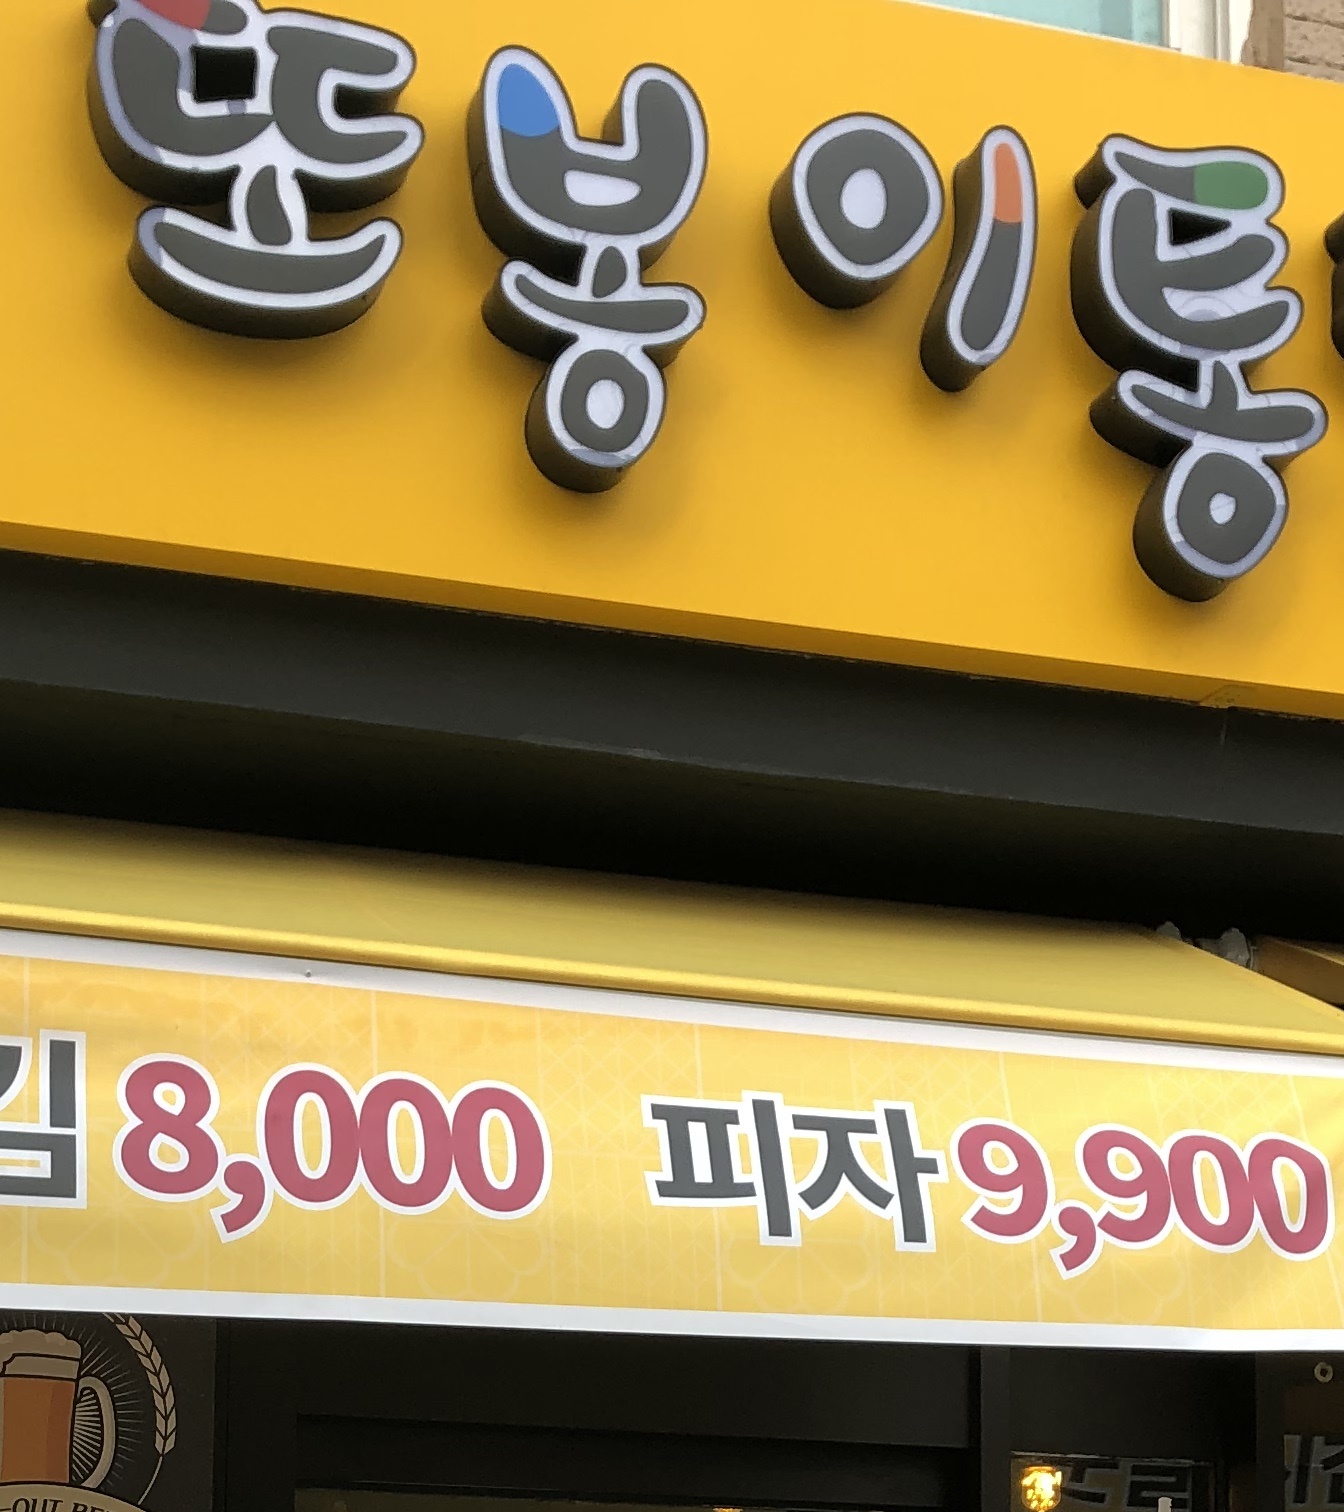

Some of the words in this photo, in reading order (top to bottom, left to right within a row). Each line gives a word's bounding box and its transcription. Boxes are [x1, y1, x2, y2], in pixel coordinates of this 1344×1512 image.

[121, 1060, 546, 1236] 8,000
[649, 1098, 940, 1245] 피자
[958, 1122, 1330, 1272] 9,900
